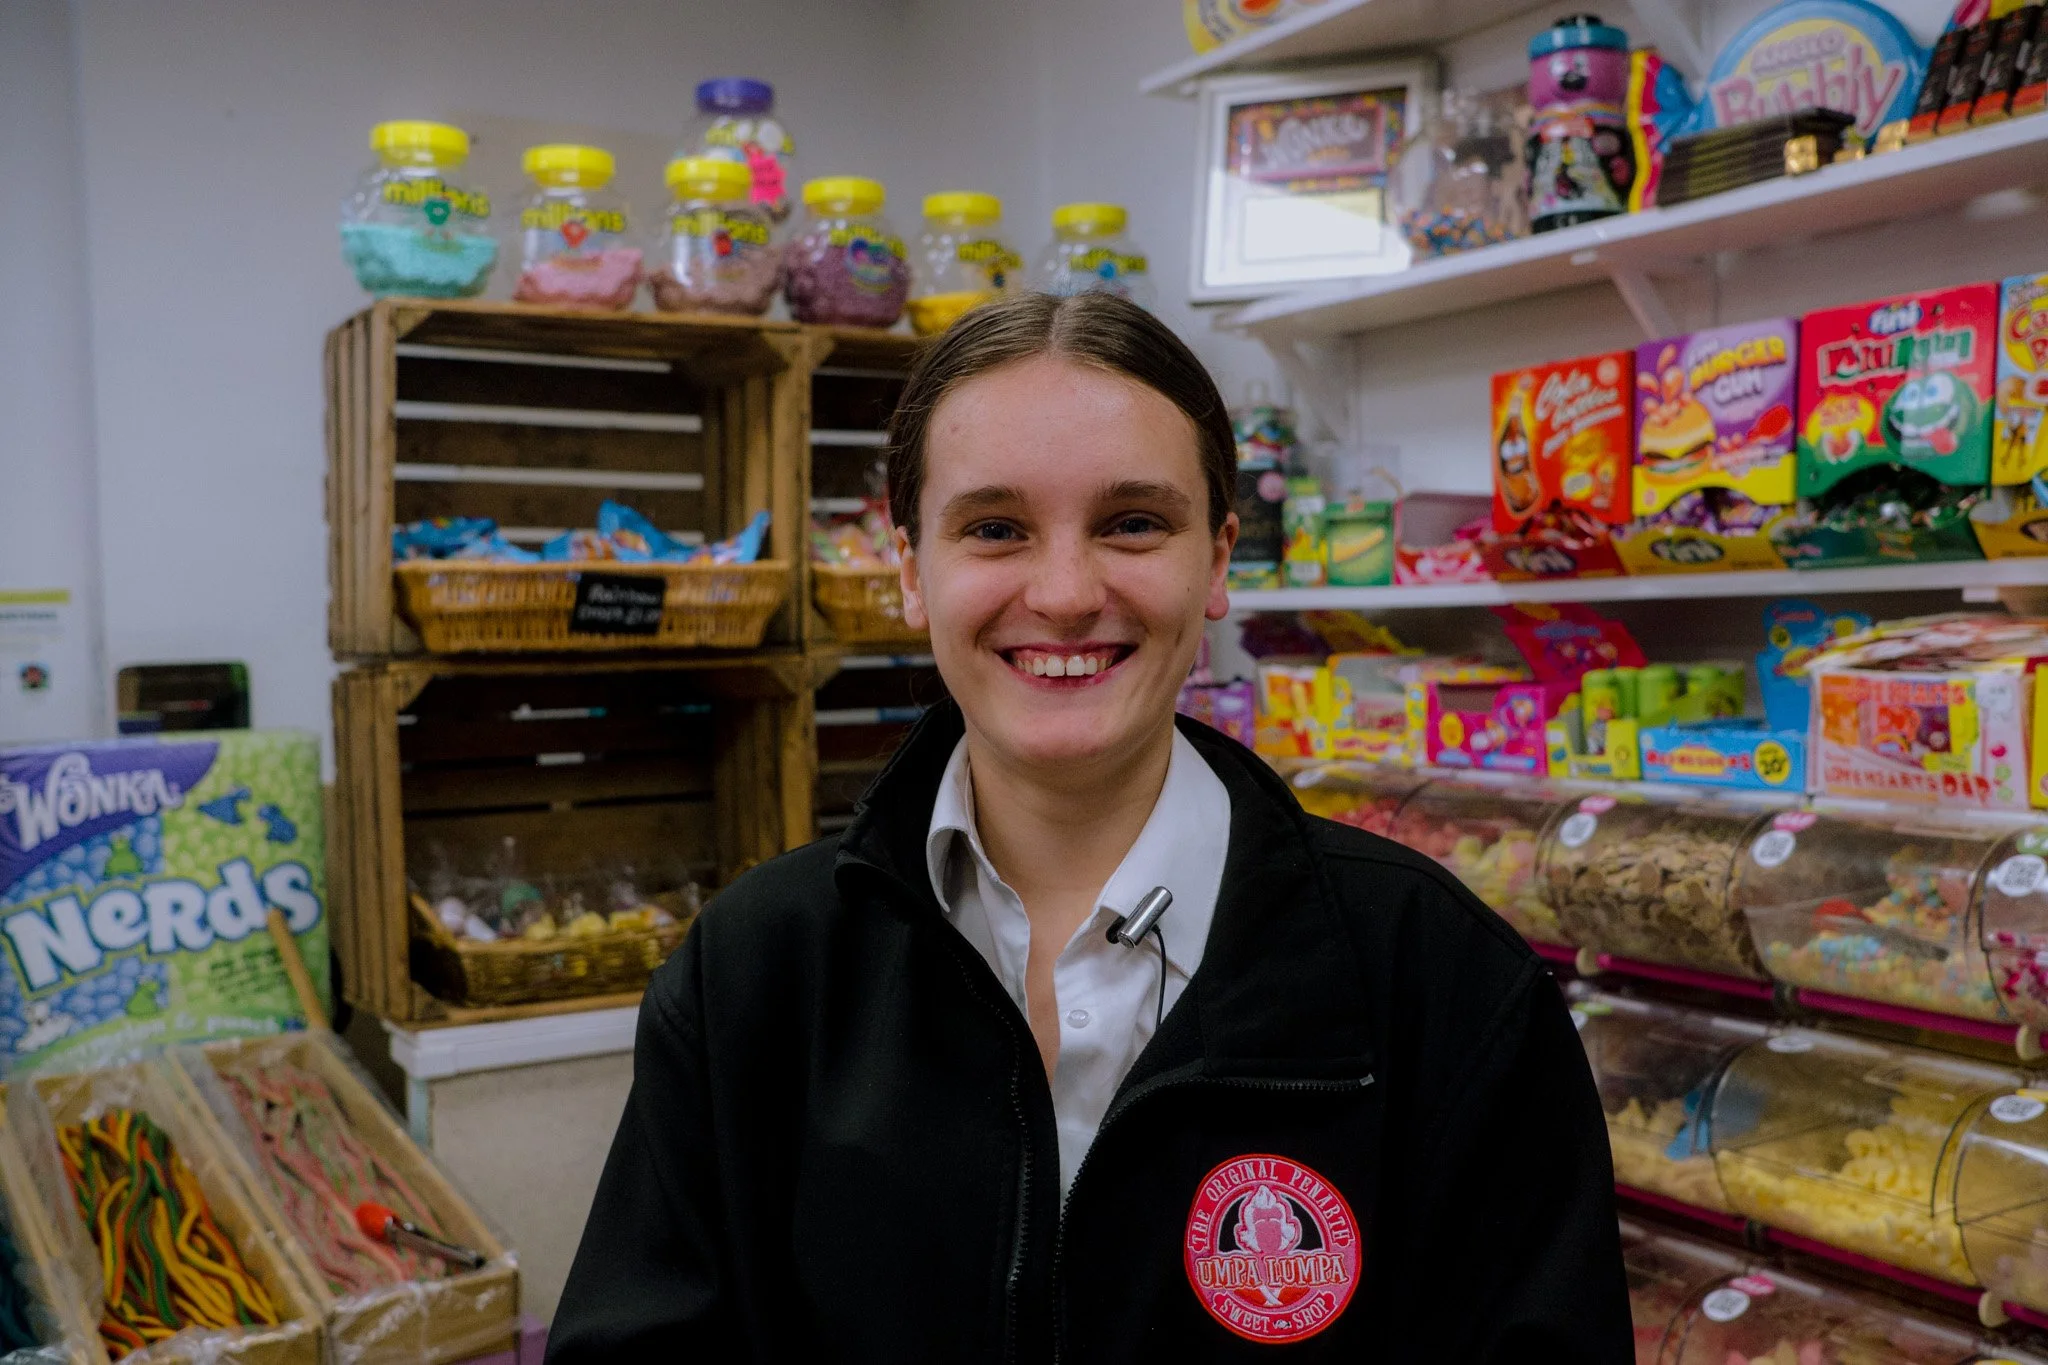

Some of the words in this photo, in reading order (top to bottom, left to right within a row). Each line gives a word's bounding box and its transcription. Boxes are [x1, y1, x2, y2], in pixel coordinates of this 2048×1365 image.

[1690, 336, 1787, 391] BURGER
[1713, 367, 1763, 404] GUM
[14, 752, 184, 851] WONKA
[1192, 1211, 1210, 1245] THE
[1206, 1160, 1279, 1202] ORIGINAL
[1289, 1168, 1351, 1246] PENARTH
[1198, 1257, 1260, 1288] UMPA
[1264, 1254, 1348, 1288] LUMPA
[1219, 1298, 1270, 1333] SWEET
[1292, 1297, 1330, 1330] SHOP
